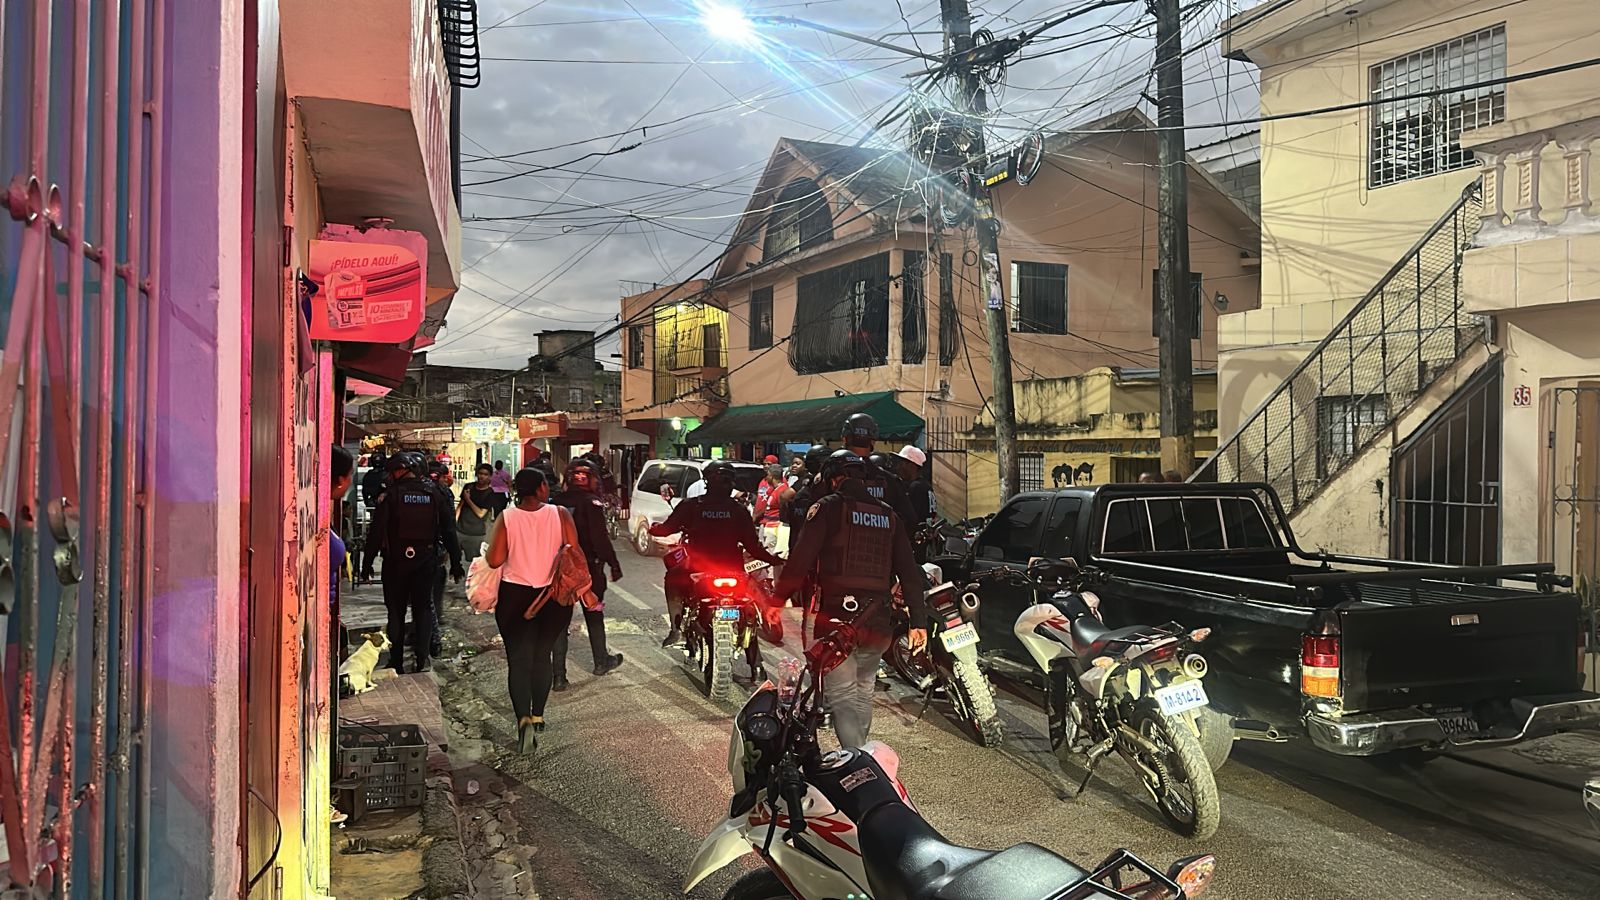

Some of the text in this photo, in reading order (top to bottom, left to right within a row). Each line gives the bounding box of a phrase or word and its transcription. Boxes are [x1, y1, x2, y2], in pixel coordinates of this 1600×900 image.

[331, 253, 399, 271] ¡PÍDELO AQUÍ!
[1514, 387, 1531, 406] 35
[404, 494, 431, 504] DICRIM
[866, 486, 884, 498] RIM
[702, 511, 731, 519] POLICIA
[852, 511, 890, 529] DICRIM
